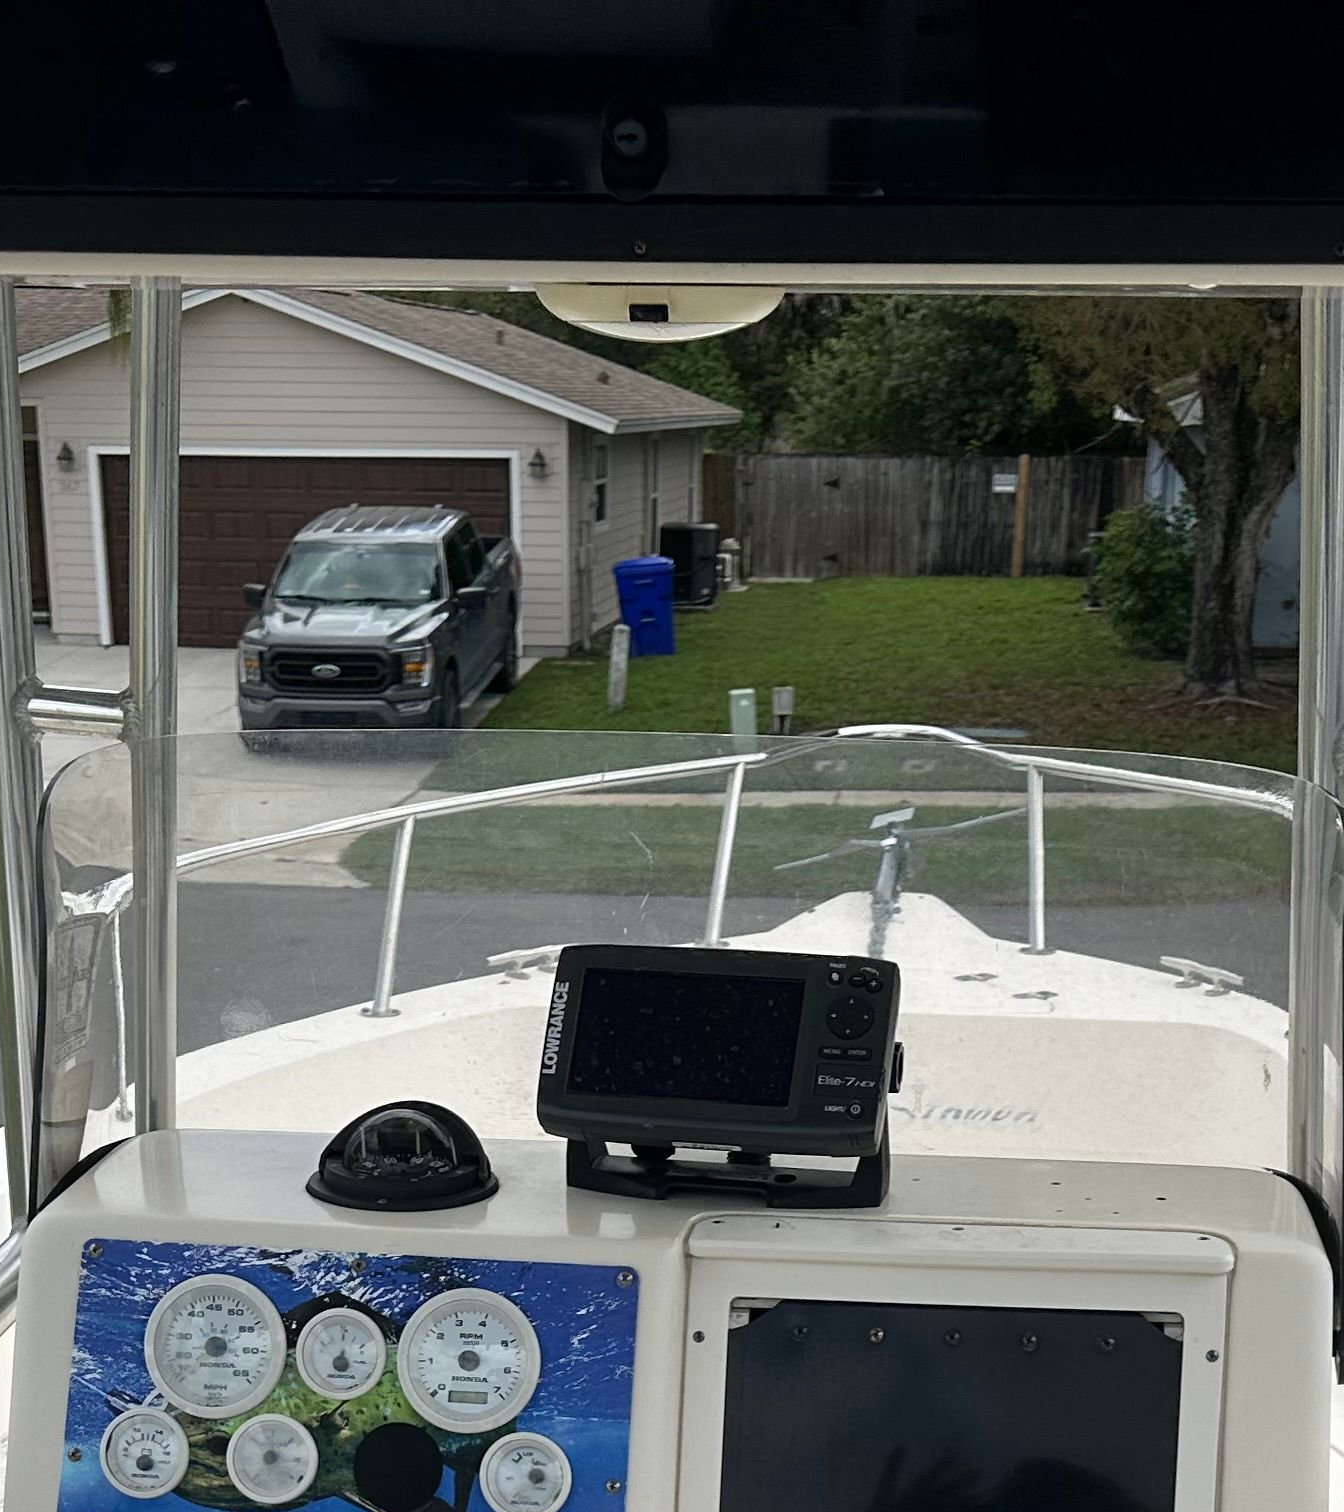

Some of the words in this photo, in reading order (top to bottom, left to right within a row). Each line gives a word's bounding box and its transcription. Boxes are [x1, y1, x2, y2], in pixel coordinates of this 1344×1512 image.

[542, 982, 570, 1075] LOWRANCE
[205, 1303, 223, 1312] 45
[455, 1319, 464, 1327] 3
[478, 1320, 488, 1328] 4
[238, 1325, 256, 1333] 55
[436, 1332, 445, 1340] 2
[459, 1332, 484, 1340] RPM
[199, 1361, 237, 1369] HONDA
[427, 1357, 434, 1365] 1
[503, 1366, 512, 1375] 6
[451, 1375, 489, 1384] HONDA
[203, 1383, 228, 1391] MPH
[437, 1383, 446, 1391] 0
[493, 1385, 502, 1395] 7
